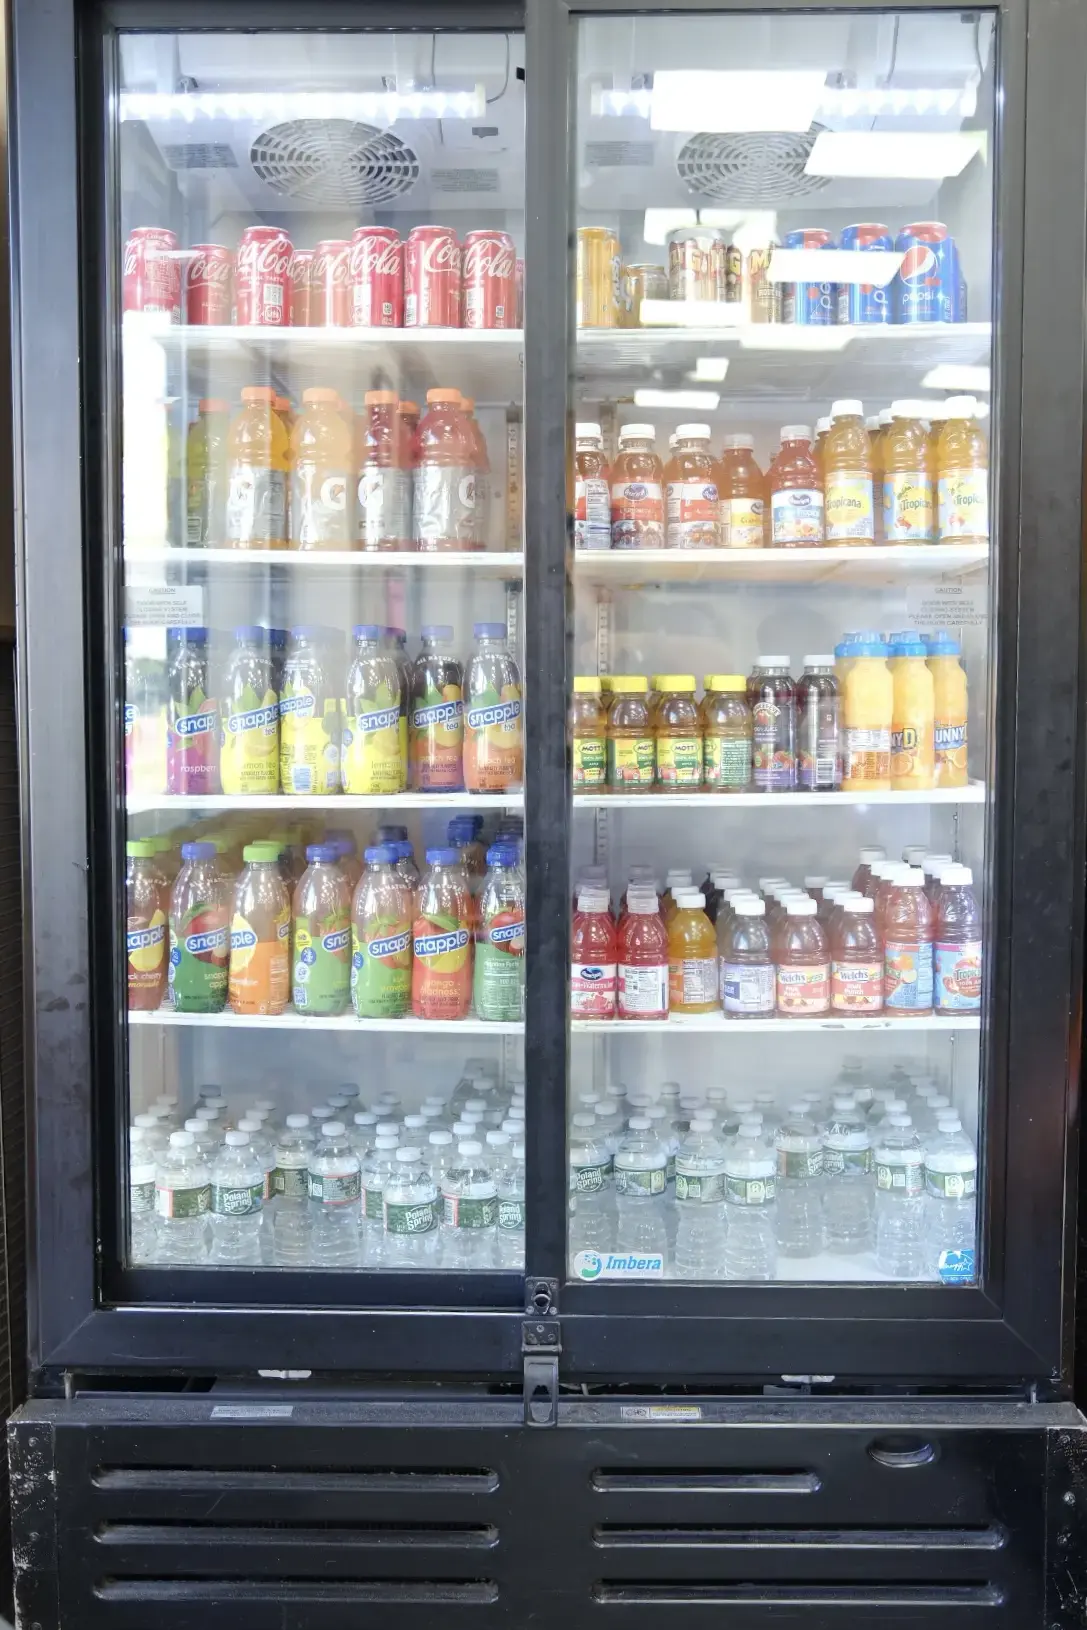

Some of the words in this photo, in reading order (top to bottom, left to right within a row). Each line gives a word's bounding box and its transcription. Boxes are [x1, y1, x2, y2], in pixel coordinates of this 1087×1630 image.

[350, 235, 400, 276] Cola
[463, 239, 513, 278] Cola
[826, 496, 862, 511] Tropicana
[231, 706, 279, 731] snapple
[415, 701, 464, 727] snapple
[469, 701, 521, 727] snapple
[446, 722, 459, 730] tea
[503, 722, 516, 732] tea
[415, 931, 468, 955] snapple
[839, 971, 869, 981] Welch's
[576, 1167, 601, 1182] Poland
[576, 1175, 602, 1190] Spring
[224, 1198, 252, 1212] Spring
[406, 1212, 433, 1231] Spring
[605, 1255, 662, 1270] Imbera
